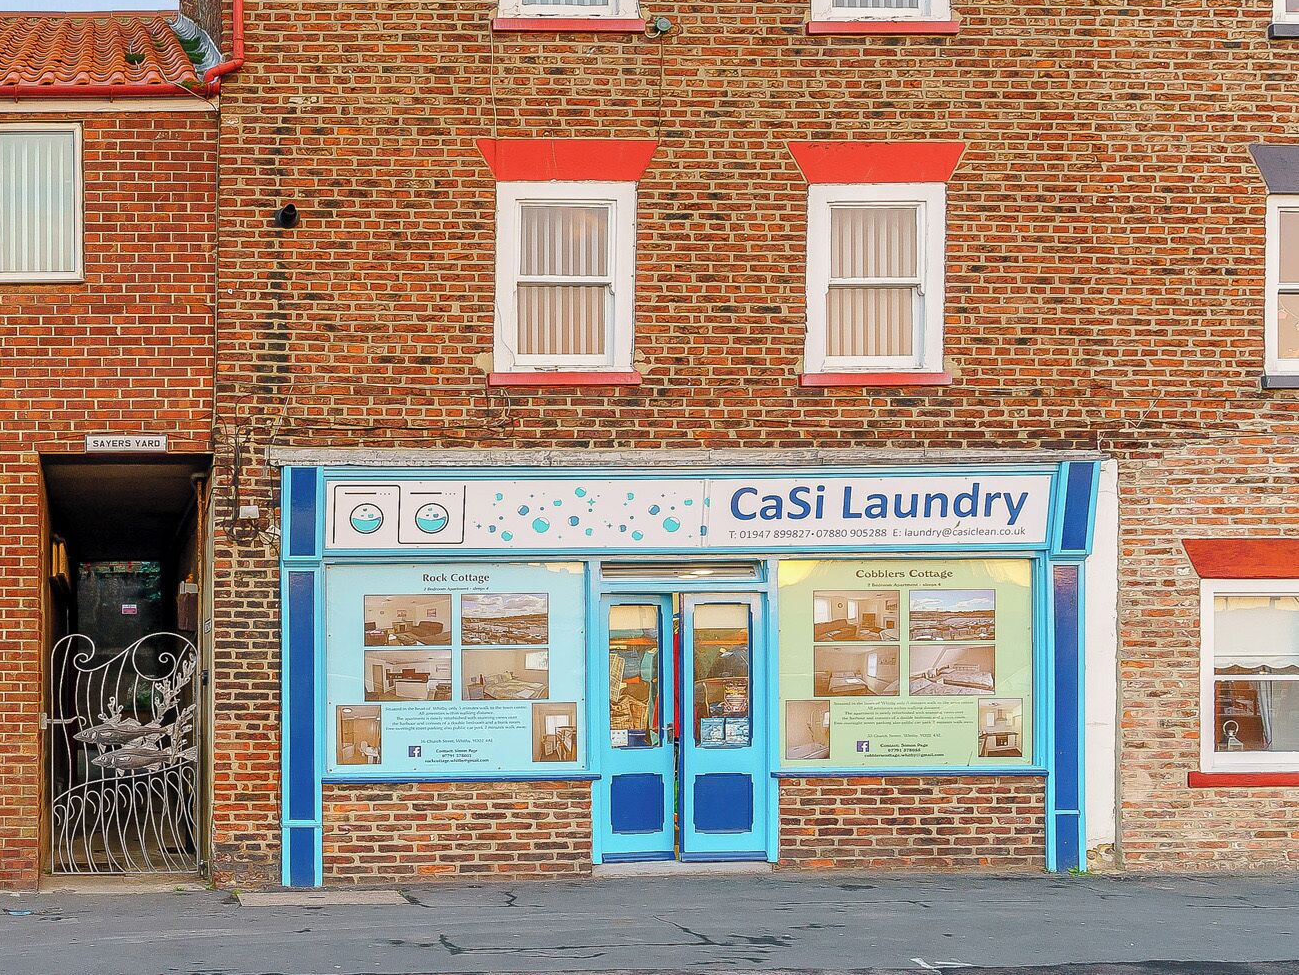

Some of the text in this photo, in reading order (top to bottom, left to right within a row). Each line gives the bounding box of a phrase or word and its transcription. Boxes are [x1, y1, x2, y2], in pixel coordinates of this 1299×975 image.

[730, 482, 1029, 526] CaSi Laundry
[728, 526, 1026, 539] T: 01947 899827 07880 905288 E: laundry@casiclean.co.uk
[422, 573, 490, 584] Rock Cottage
[856, 569, 954, 579] Cobblers Cottage
